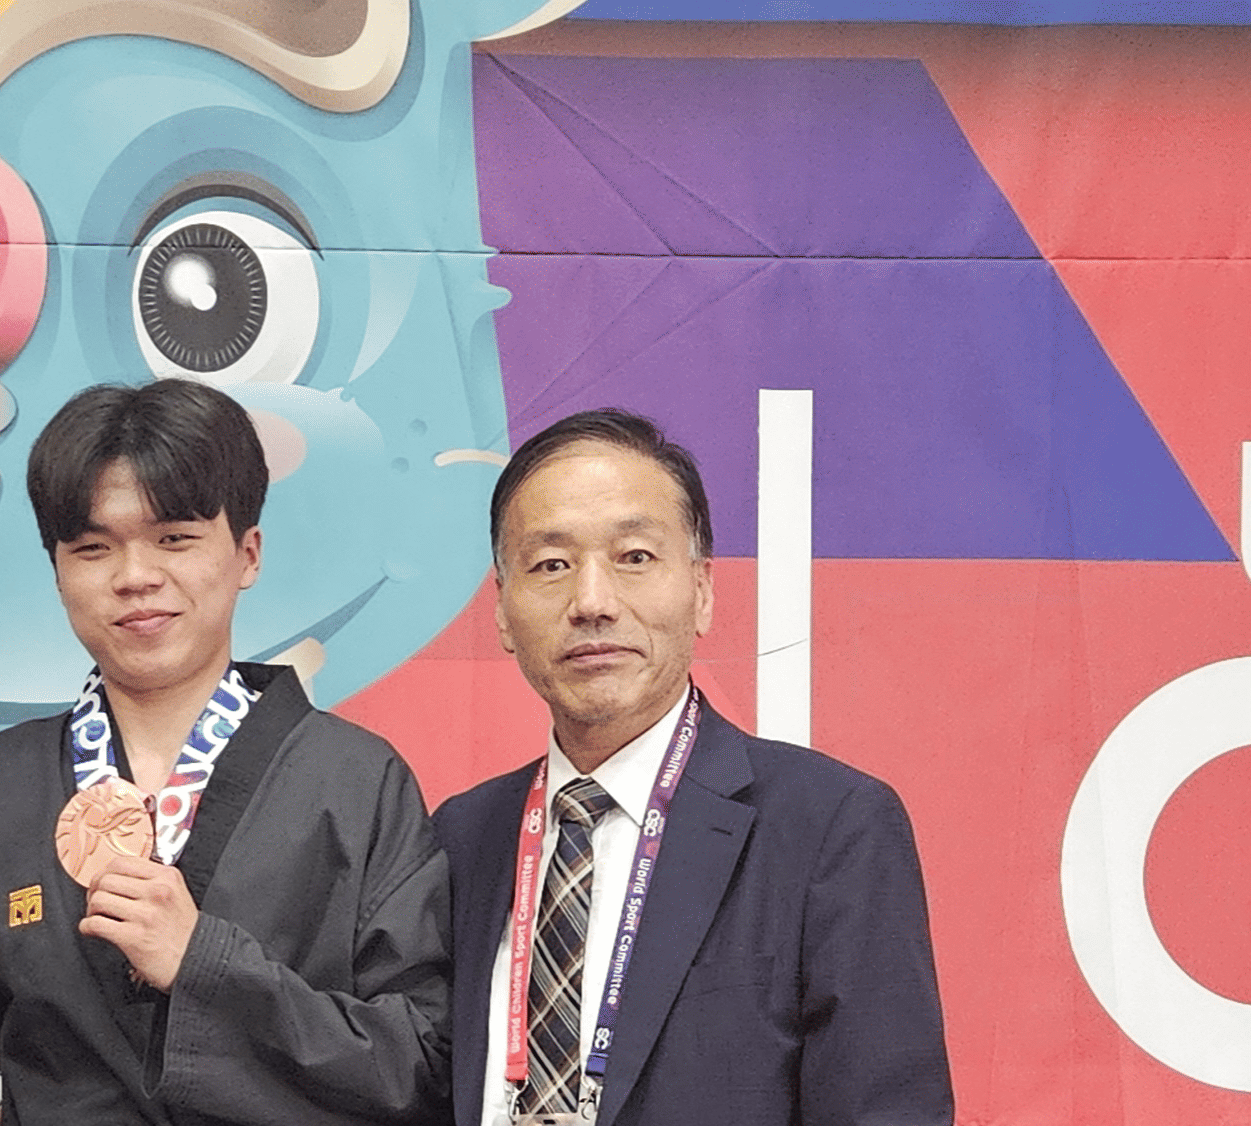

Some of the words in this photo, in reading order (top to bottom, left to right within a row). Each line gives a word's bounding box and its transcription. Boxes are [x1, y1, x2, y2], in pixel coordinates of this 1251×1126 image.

[518, 855, 534, 921] Committee
[633, 858, 651, 895] World
[623, 898, 641, 931] Sport
[515, 924, 527, 959] Sport
[512, 962, 524, 1014] Children
[607, 934, 633, 1005] Committee
[510, 1017, 522, 1054] World
